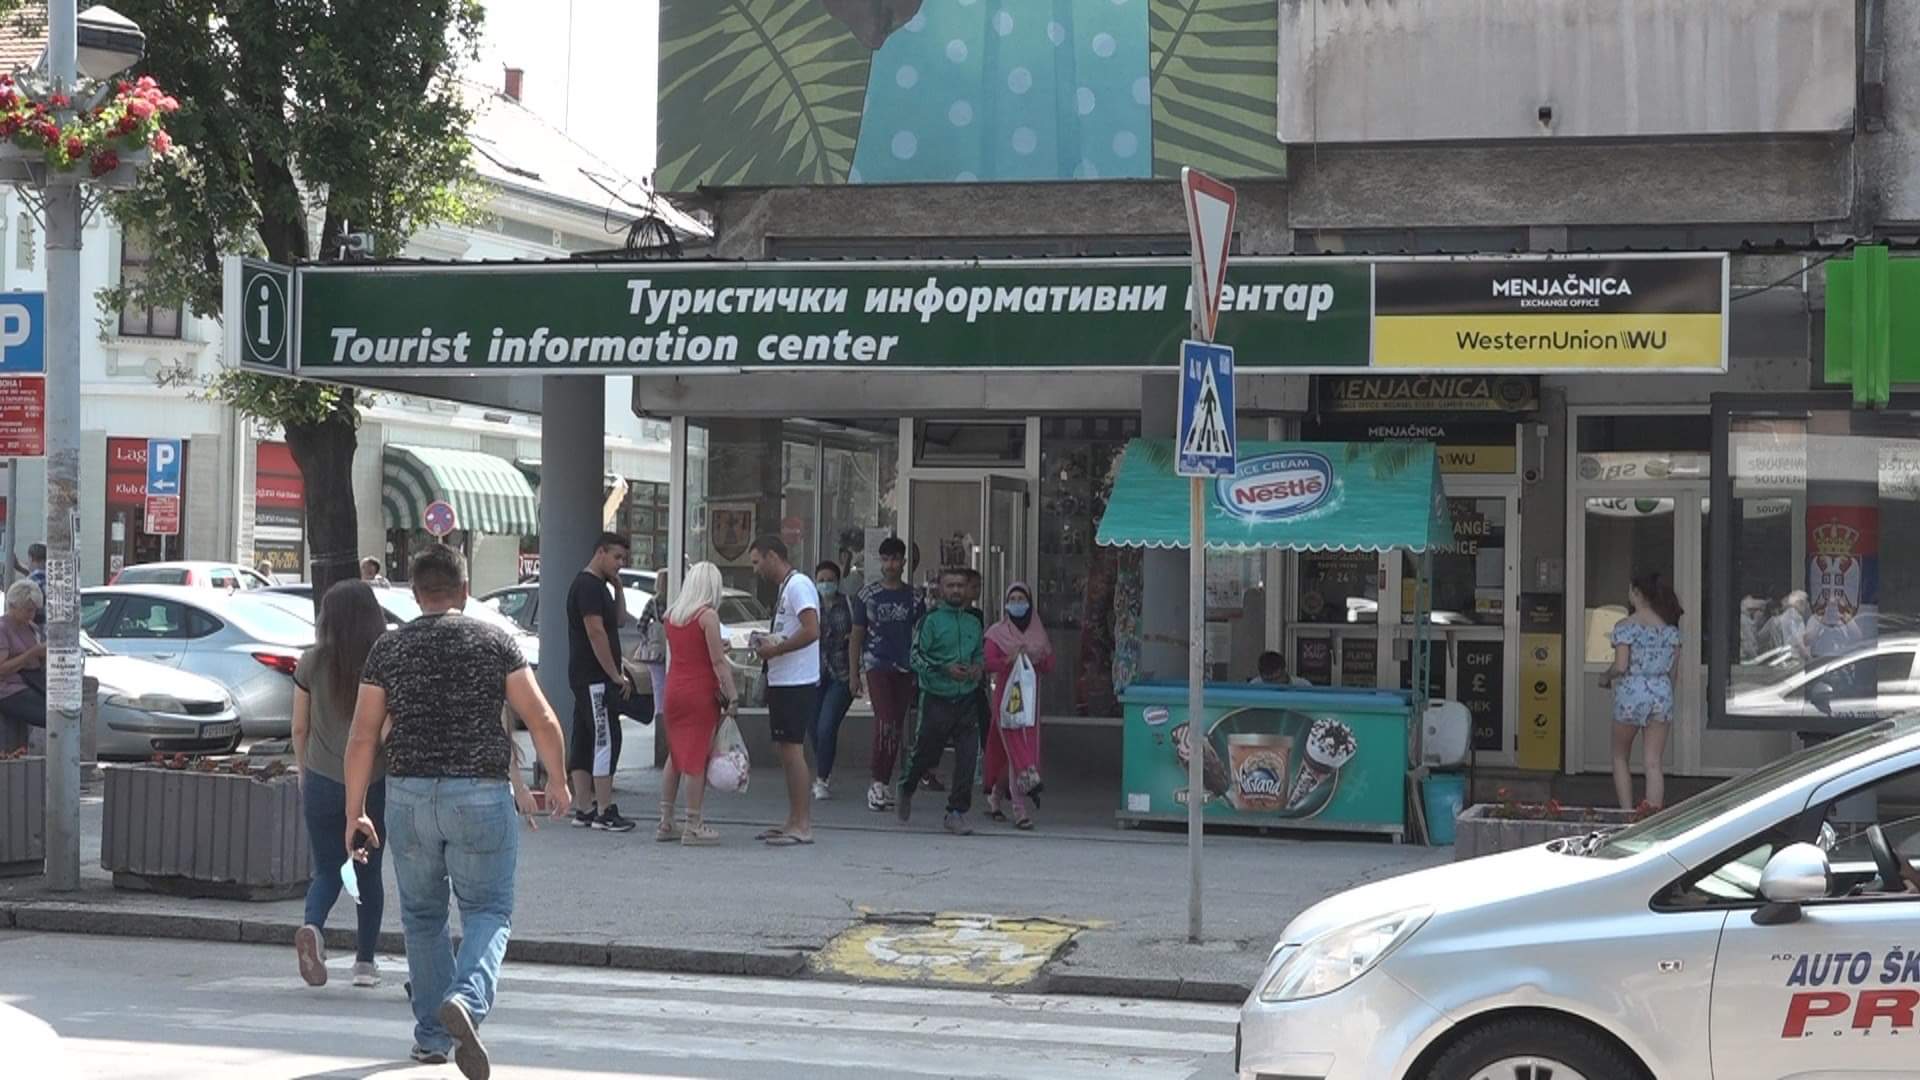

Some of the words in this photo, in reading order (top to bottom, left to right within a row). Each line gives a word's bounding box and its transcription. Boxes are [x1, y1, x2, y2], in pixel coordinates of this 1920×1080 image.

[1492, 273, 1632, 297] MENJAČNICA
[626, 278, 847, 326] Туристички
[864, 277, 1167, 323] информативни
[1185, 282, 1334, 322] ентар
[1520, 299, 1569, 307] EXCHANGE
[1571, 298, 1600, 307] OFFICE
[331, 327, 471, 363] Tourist
[488, 326, 740, 363] information
[757, 329, 899, 363] center
[1368, 424, 1446, 437] MENJAČNICA
[156, 444, 174, 472] P
[1239, 466, 1259, 478] ICE
[1262, 458, 1310, 471] CREAM
[116, 484, 138, 494] Klub
[1466, 653, 1493, 665] CHF
[1234, 766, 1281, 796] Nirvana
[1786, 952, 1872, 987] AUTO
[1880, 945, 1920, 984] ŠK
[1781, 989, 1920, 1039] PR
